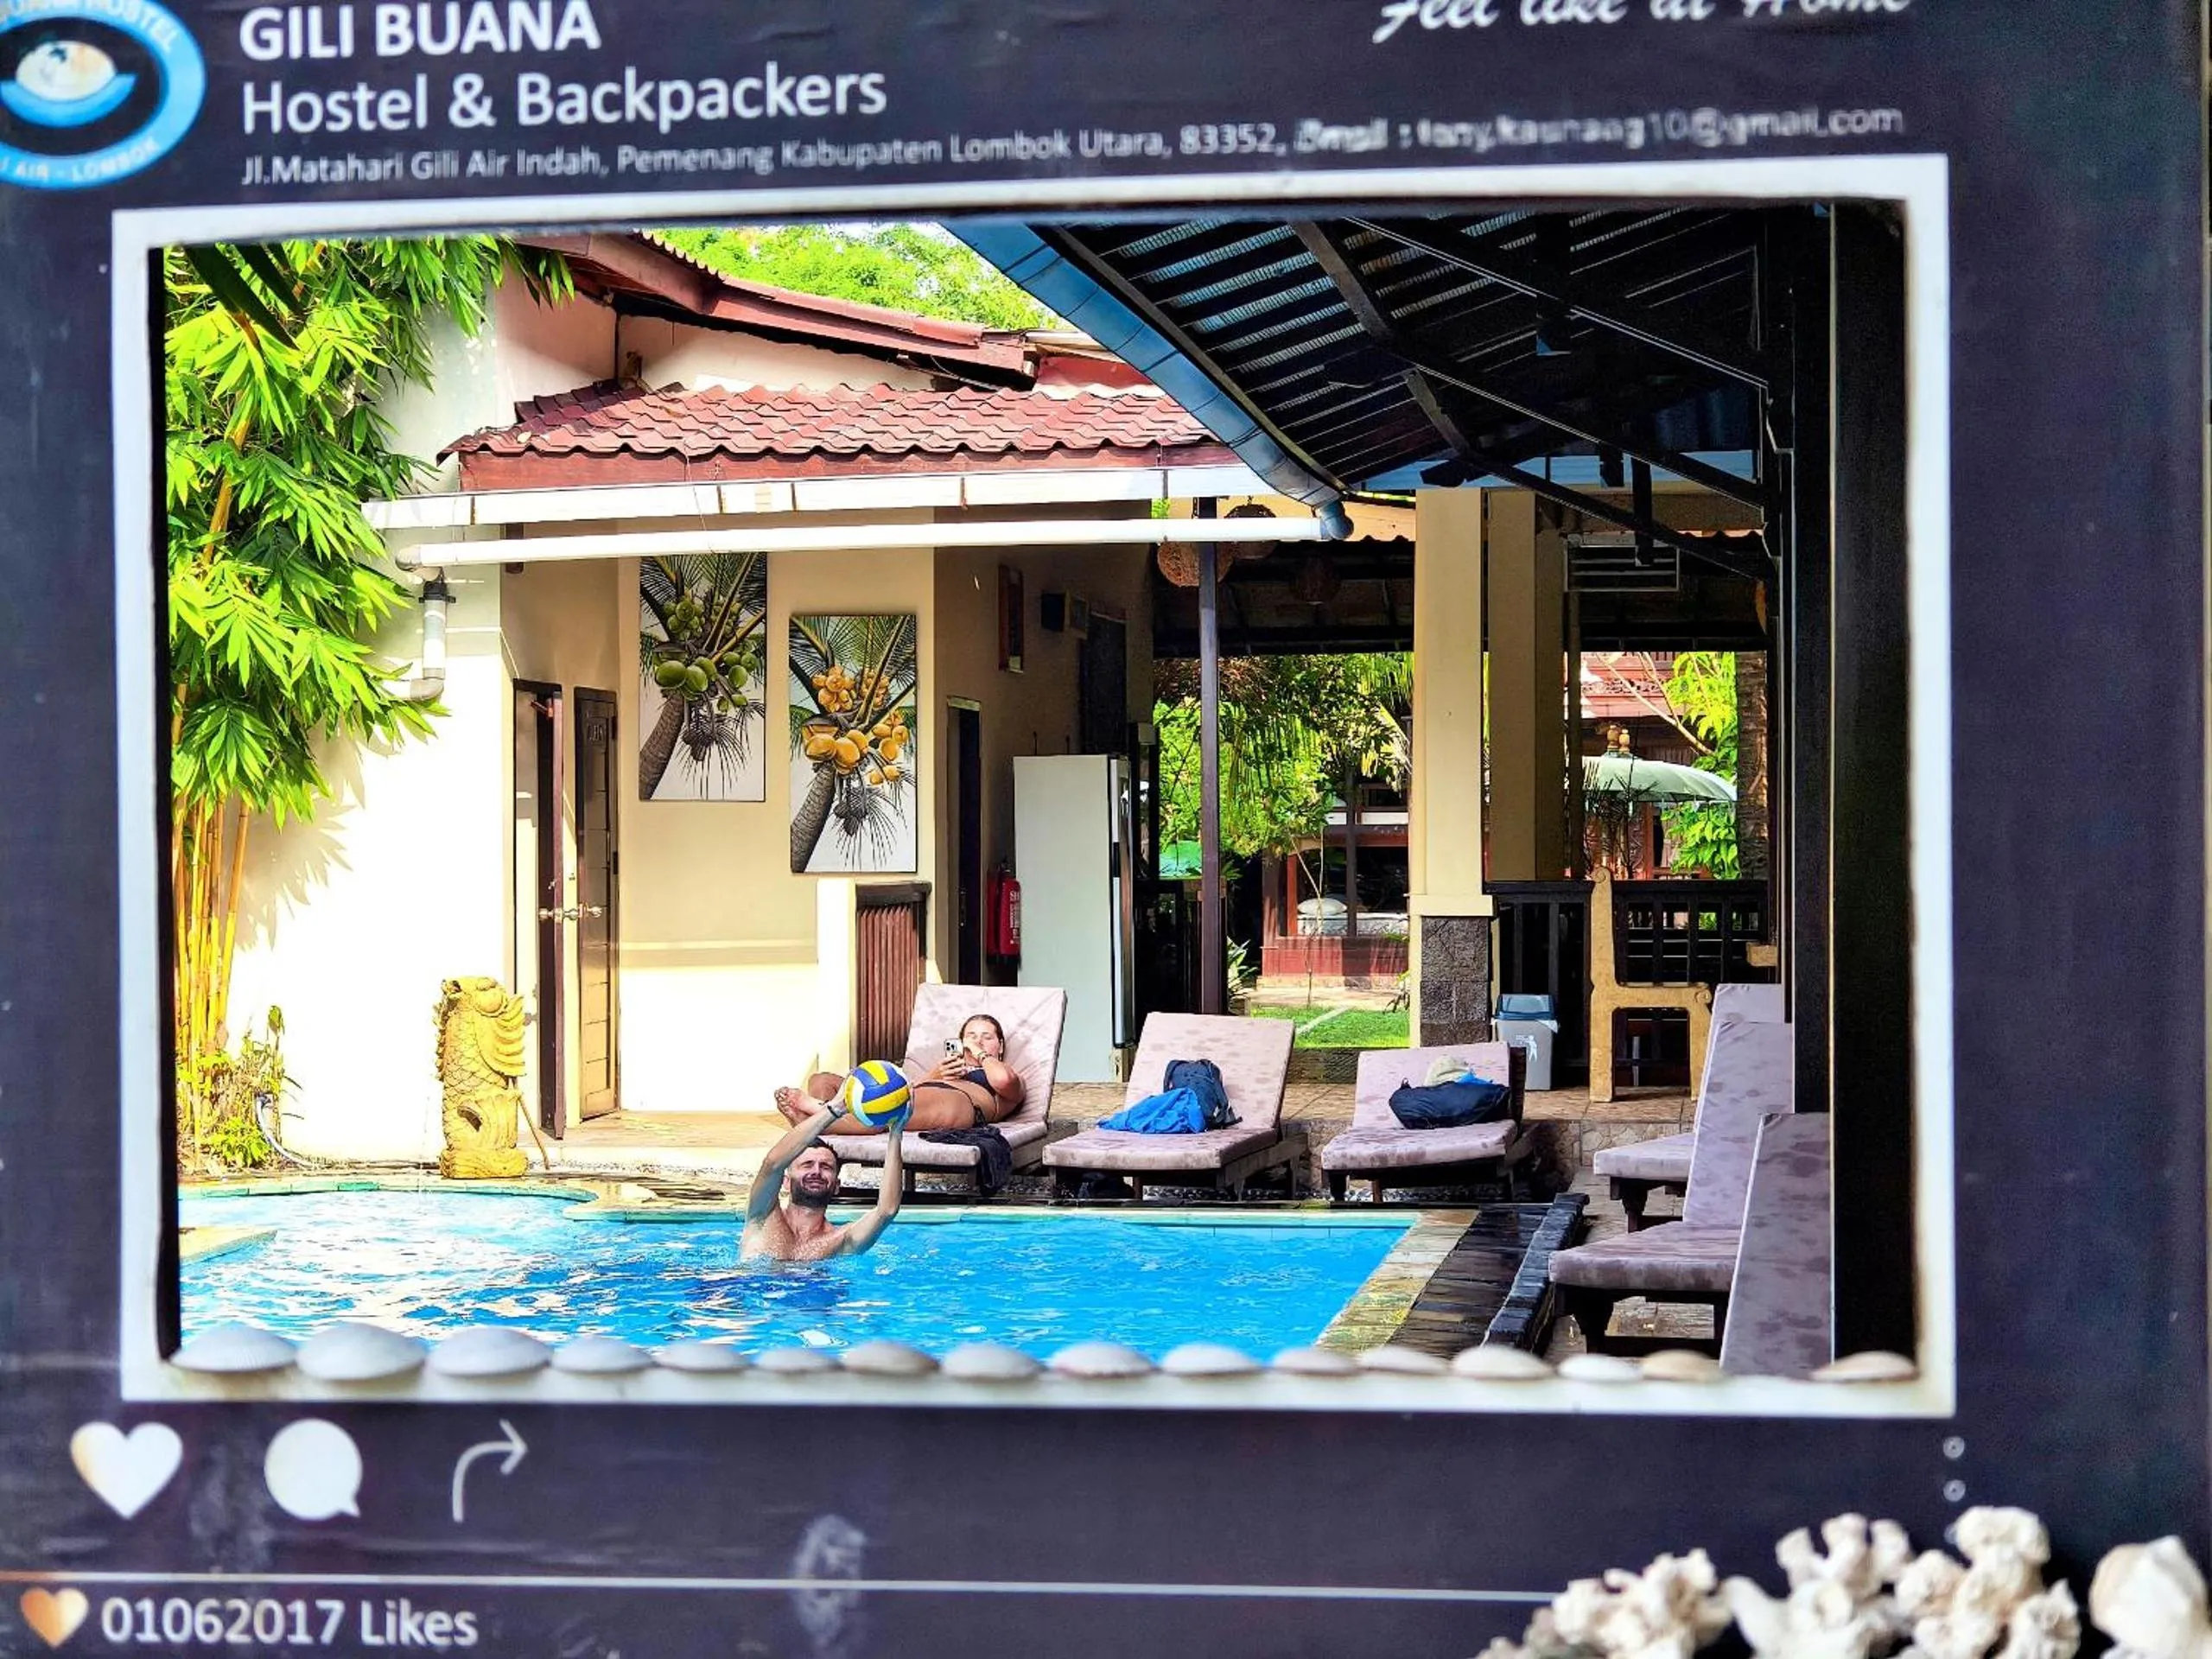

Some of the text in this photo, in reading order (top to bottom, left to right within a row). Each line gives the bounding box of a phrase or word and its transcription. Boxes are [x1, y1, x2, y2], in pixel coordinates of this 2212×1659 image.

[239, 0, 602, 60] GILI BUANA
[243, 60, 887, 134] Hostel & Backpackers
[410, 149, 458, 180] Gili
[465, 149, 511, 178] Air
[516, 143, 610, 177] Indah,
[616, 143, 775, 175] Pemenang
[780, 134, 944, 170] Kabupaten
[950, 128, 1072, 163] Lombok
[100, 1596, 479, 1647] 01062017 Likes
